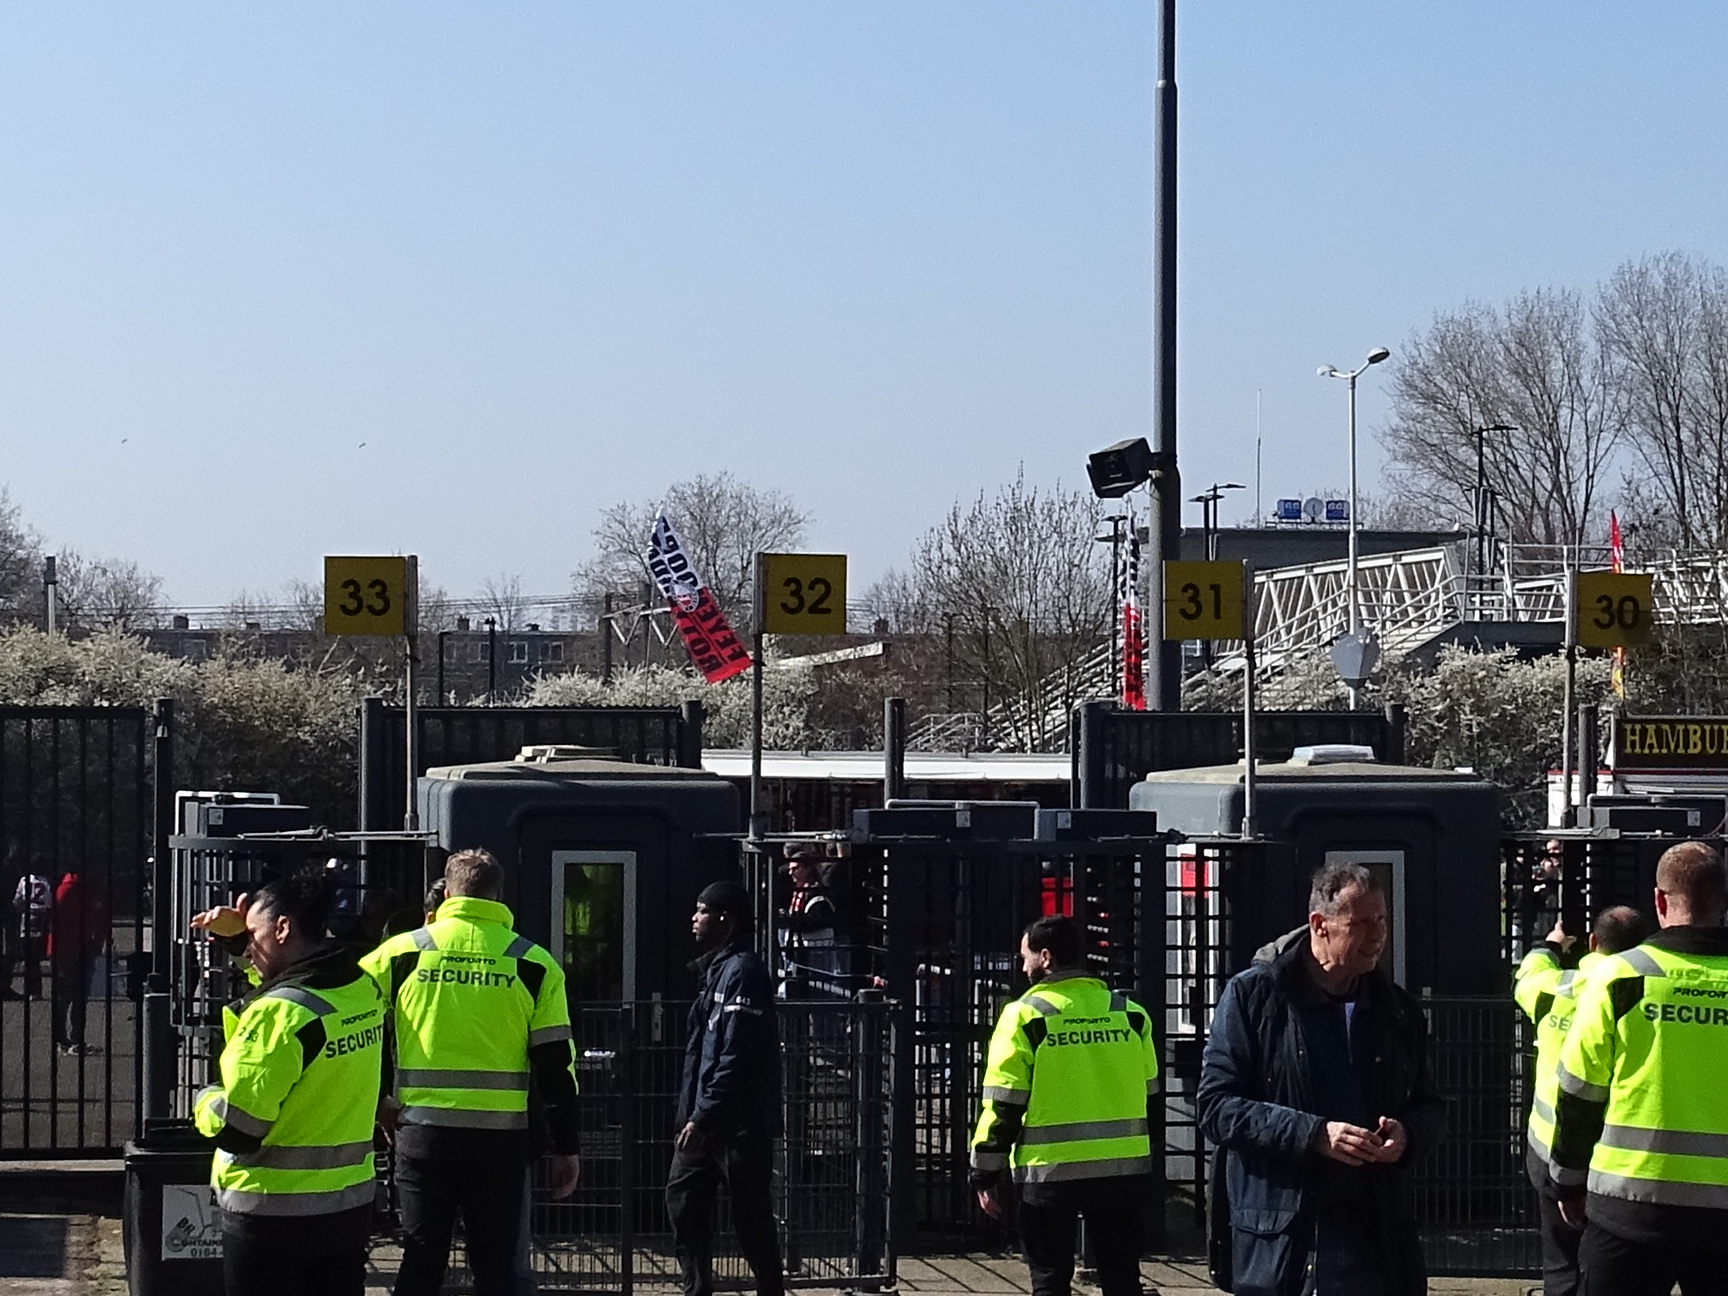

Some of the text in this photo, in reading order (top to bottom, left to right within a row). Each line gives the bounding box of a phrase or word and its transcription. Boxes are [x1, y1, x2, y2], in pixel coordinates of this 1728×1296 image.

[339, 578, 391, 617] 33
[780, 576, 832, 615] 32
[1178, 582, 1221, 621] 31
[1593, 594, 1640, 630] 30
[417, 968, 516, 989] SECURITY
[325, 1024, 384, 1059] SECURIT
[1047, 1029, 1131, 1047] SECURITY
